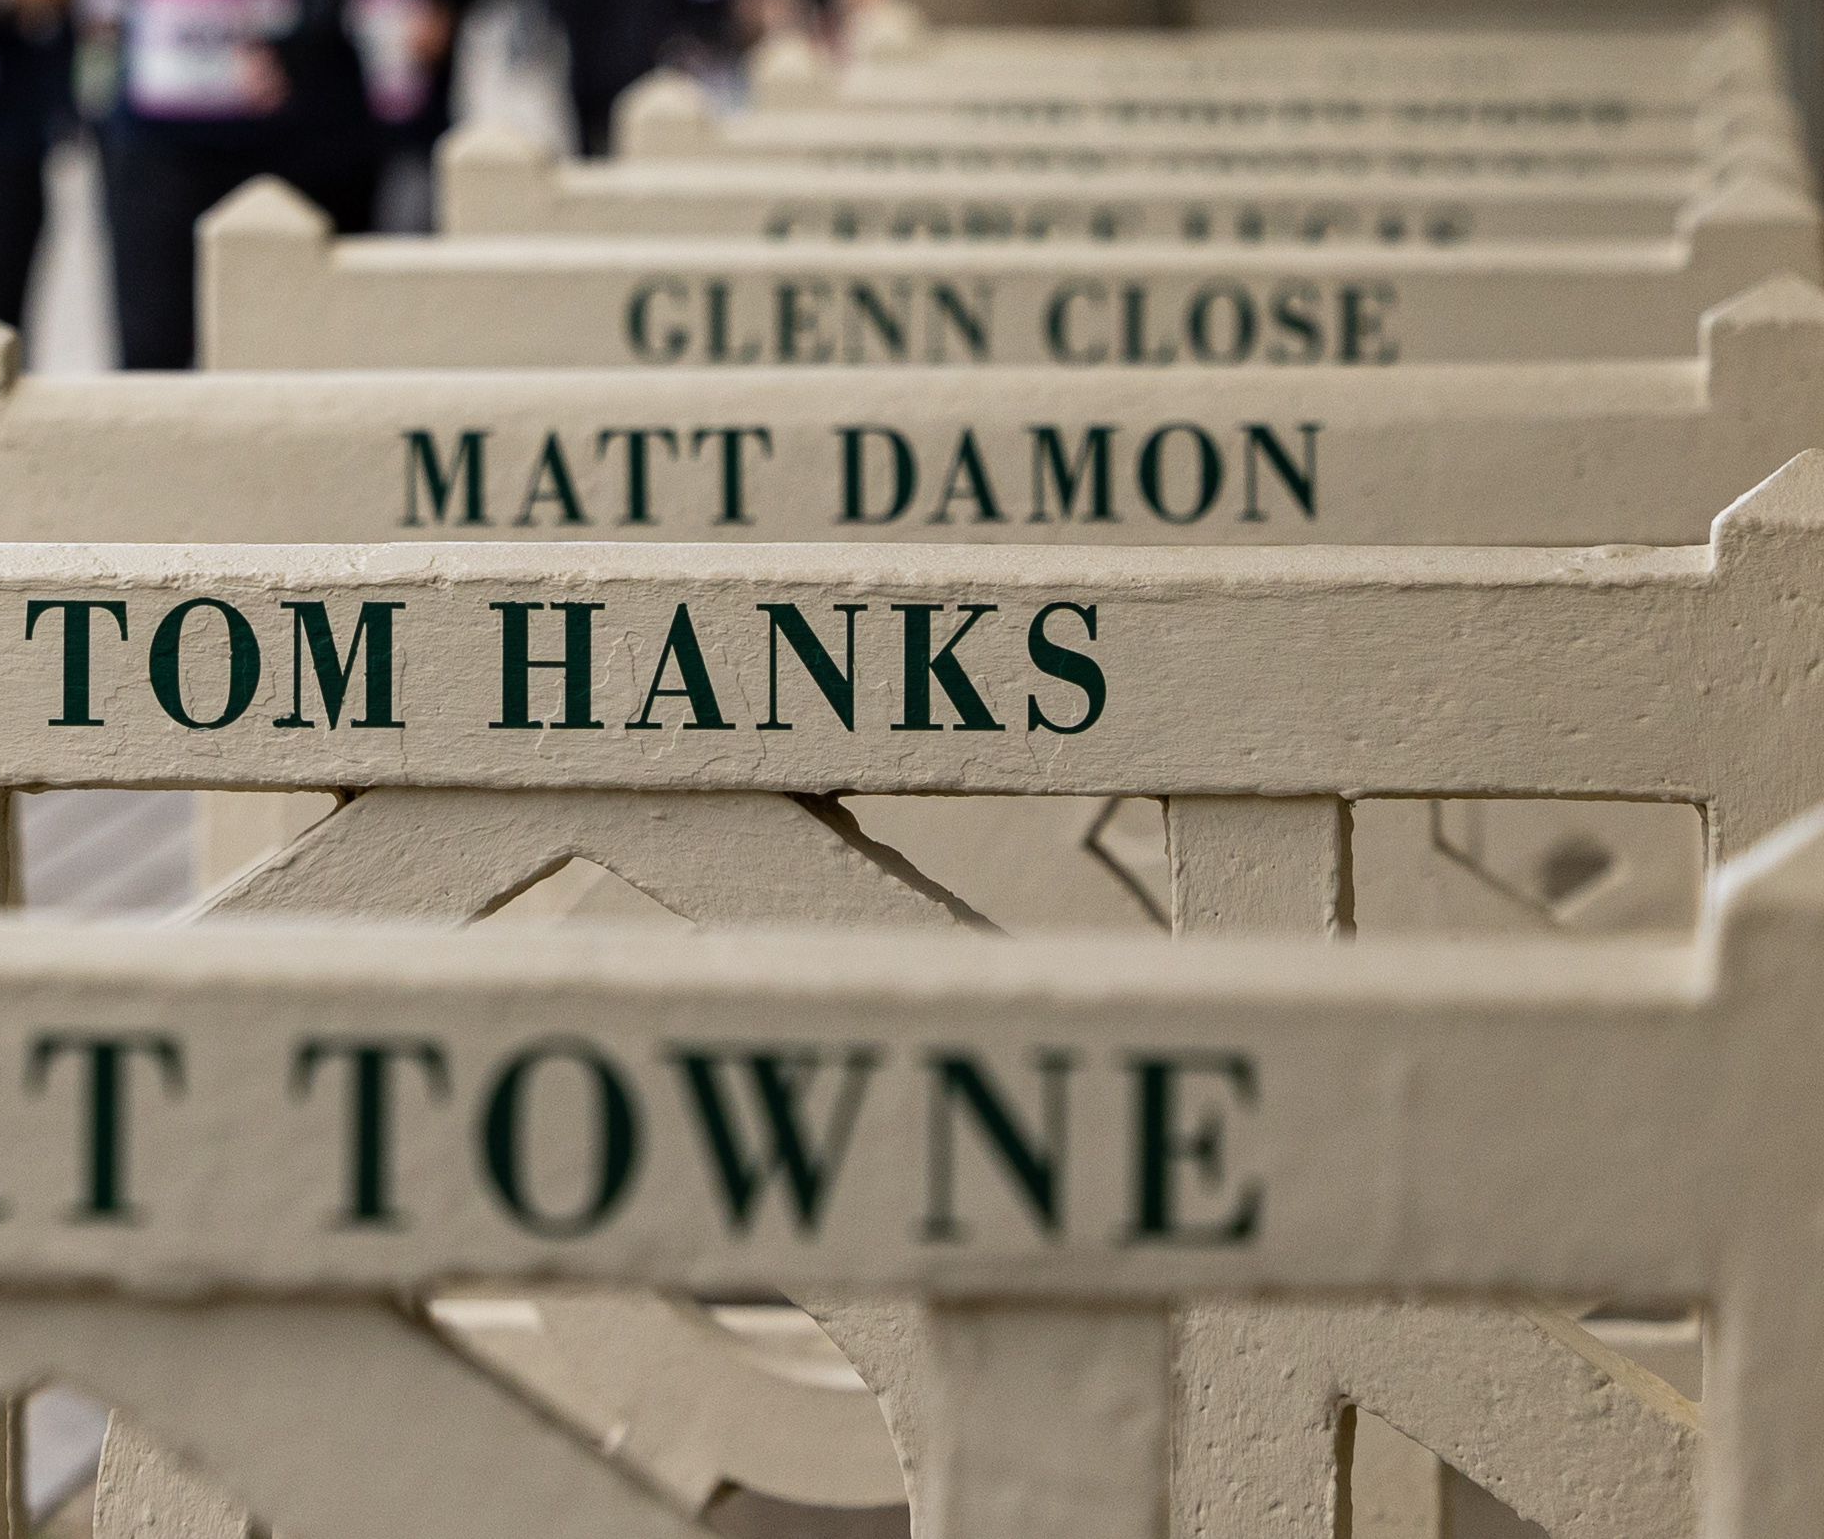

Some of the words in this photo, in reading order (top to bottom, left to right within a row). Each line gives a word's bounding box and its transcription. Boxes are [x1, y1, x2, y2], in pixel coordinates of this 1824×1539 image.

[625, 275, 996, 366] GLENN
[1040, 276, 1402, 366] CLOSE
[400, 427, 774, 527] MATT
[833, 422, 1326, 525] DAMON
[24, 595, 407, 731] TOM
[488, 599, 1108, 736] HANKS
[290, 1033, 1266, 1251] TOWNE
